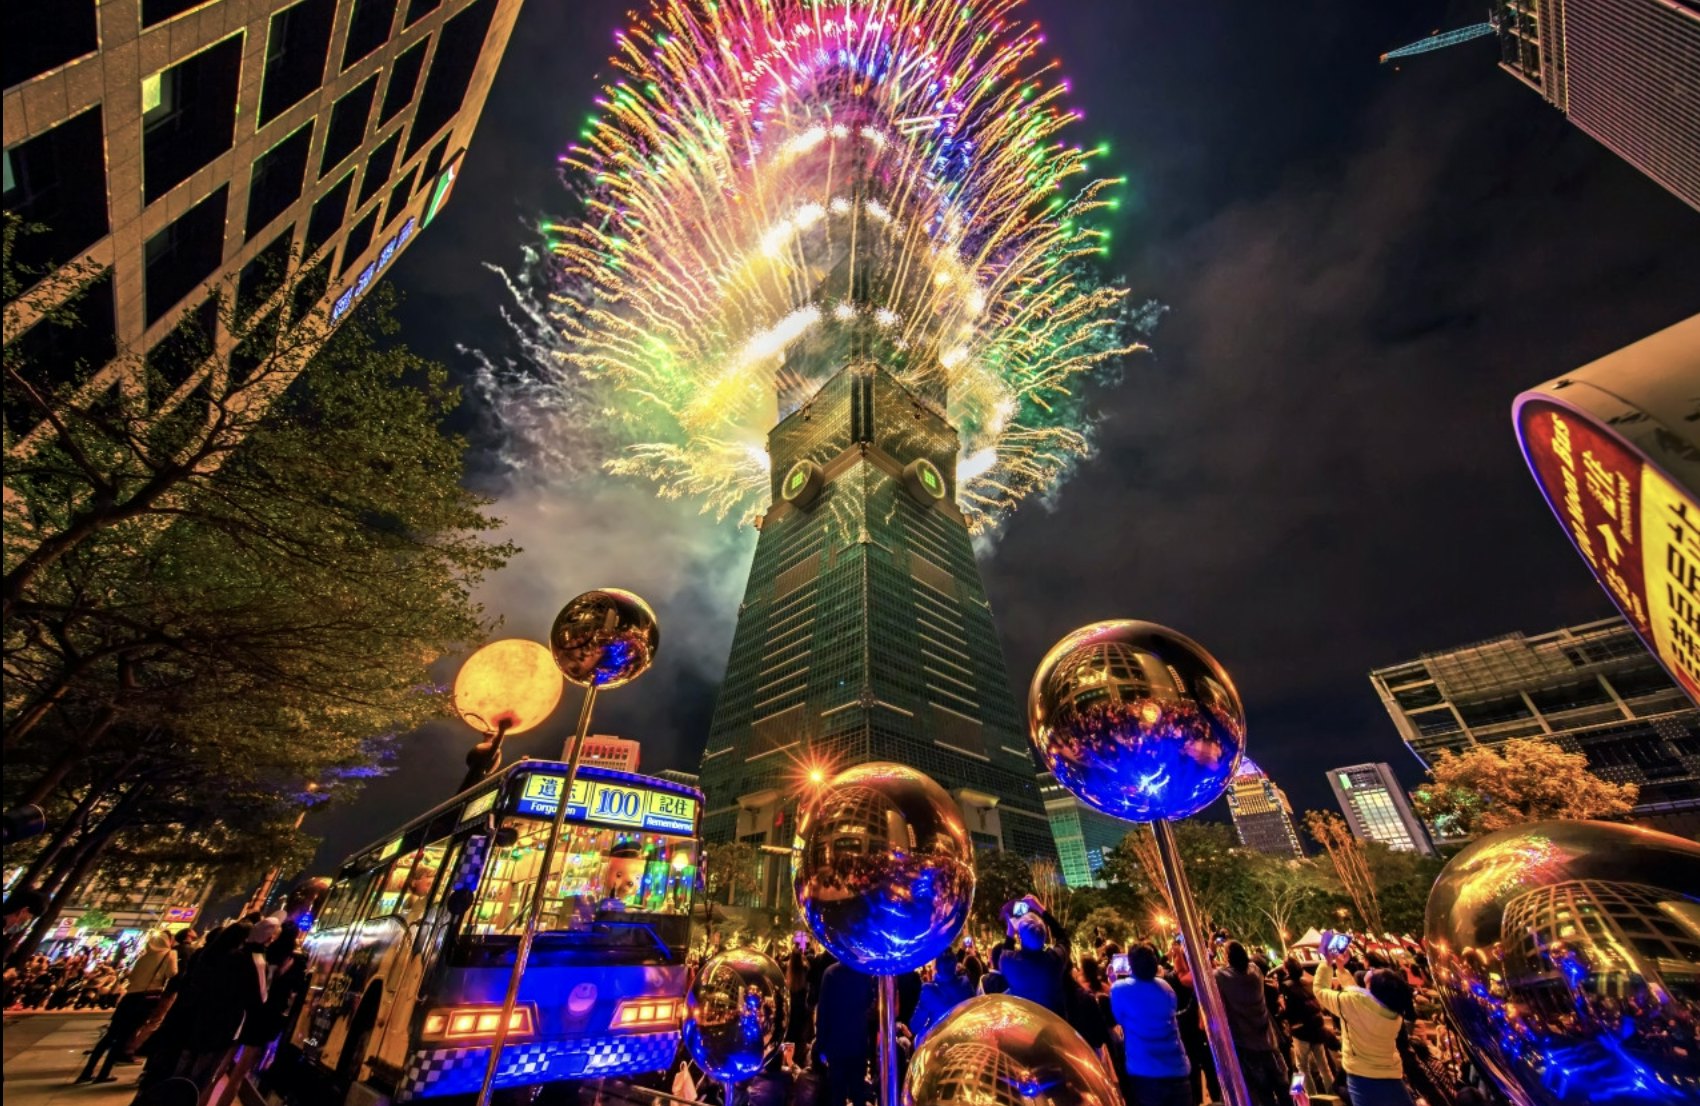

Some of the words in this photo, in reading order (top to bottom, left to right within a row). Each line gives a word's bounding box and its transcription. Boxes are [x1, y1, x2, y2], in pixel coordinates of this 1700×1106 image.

[1551, 412, 1574, 472] Bus
[530, 801, 576, 816] Forgoen
[595, 788, 640, 816] 100
[659, 796, 688, 816] 記住
